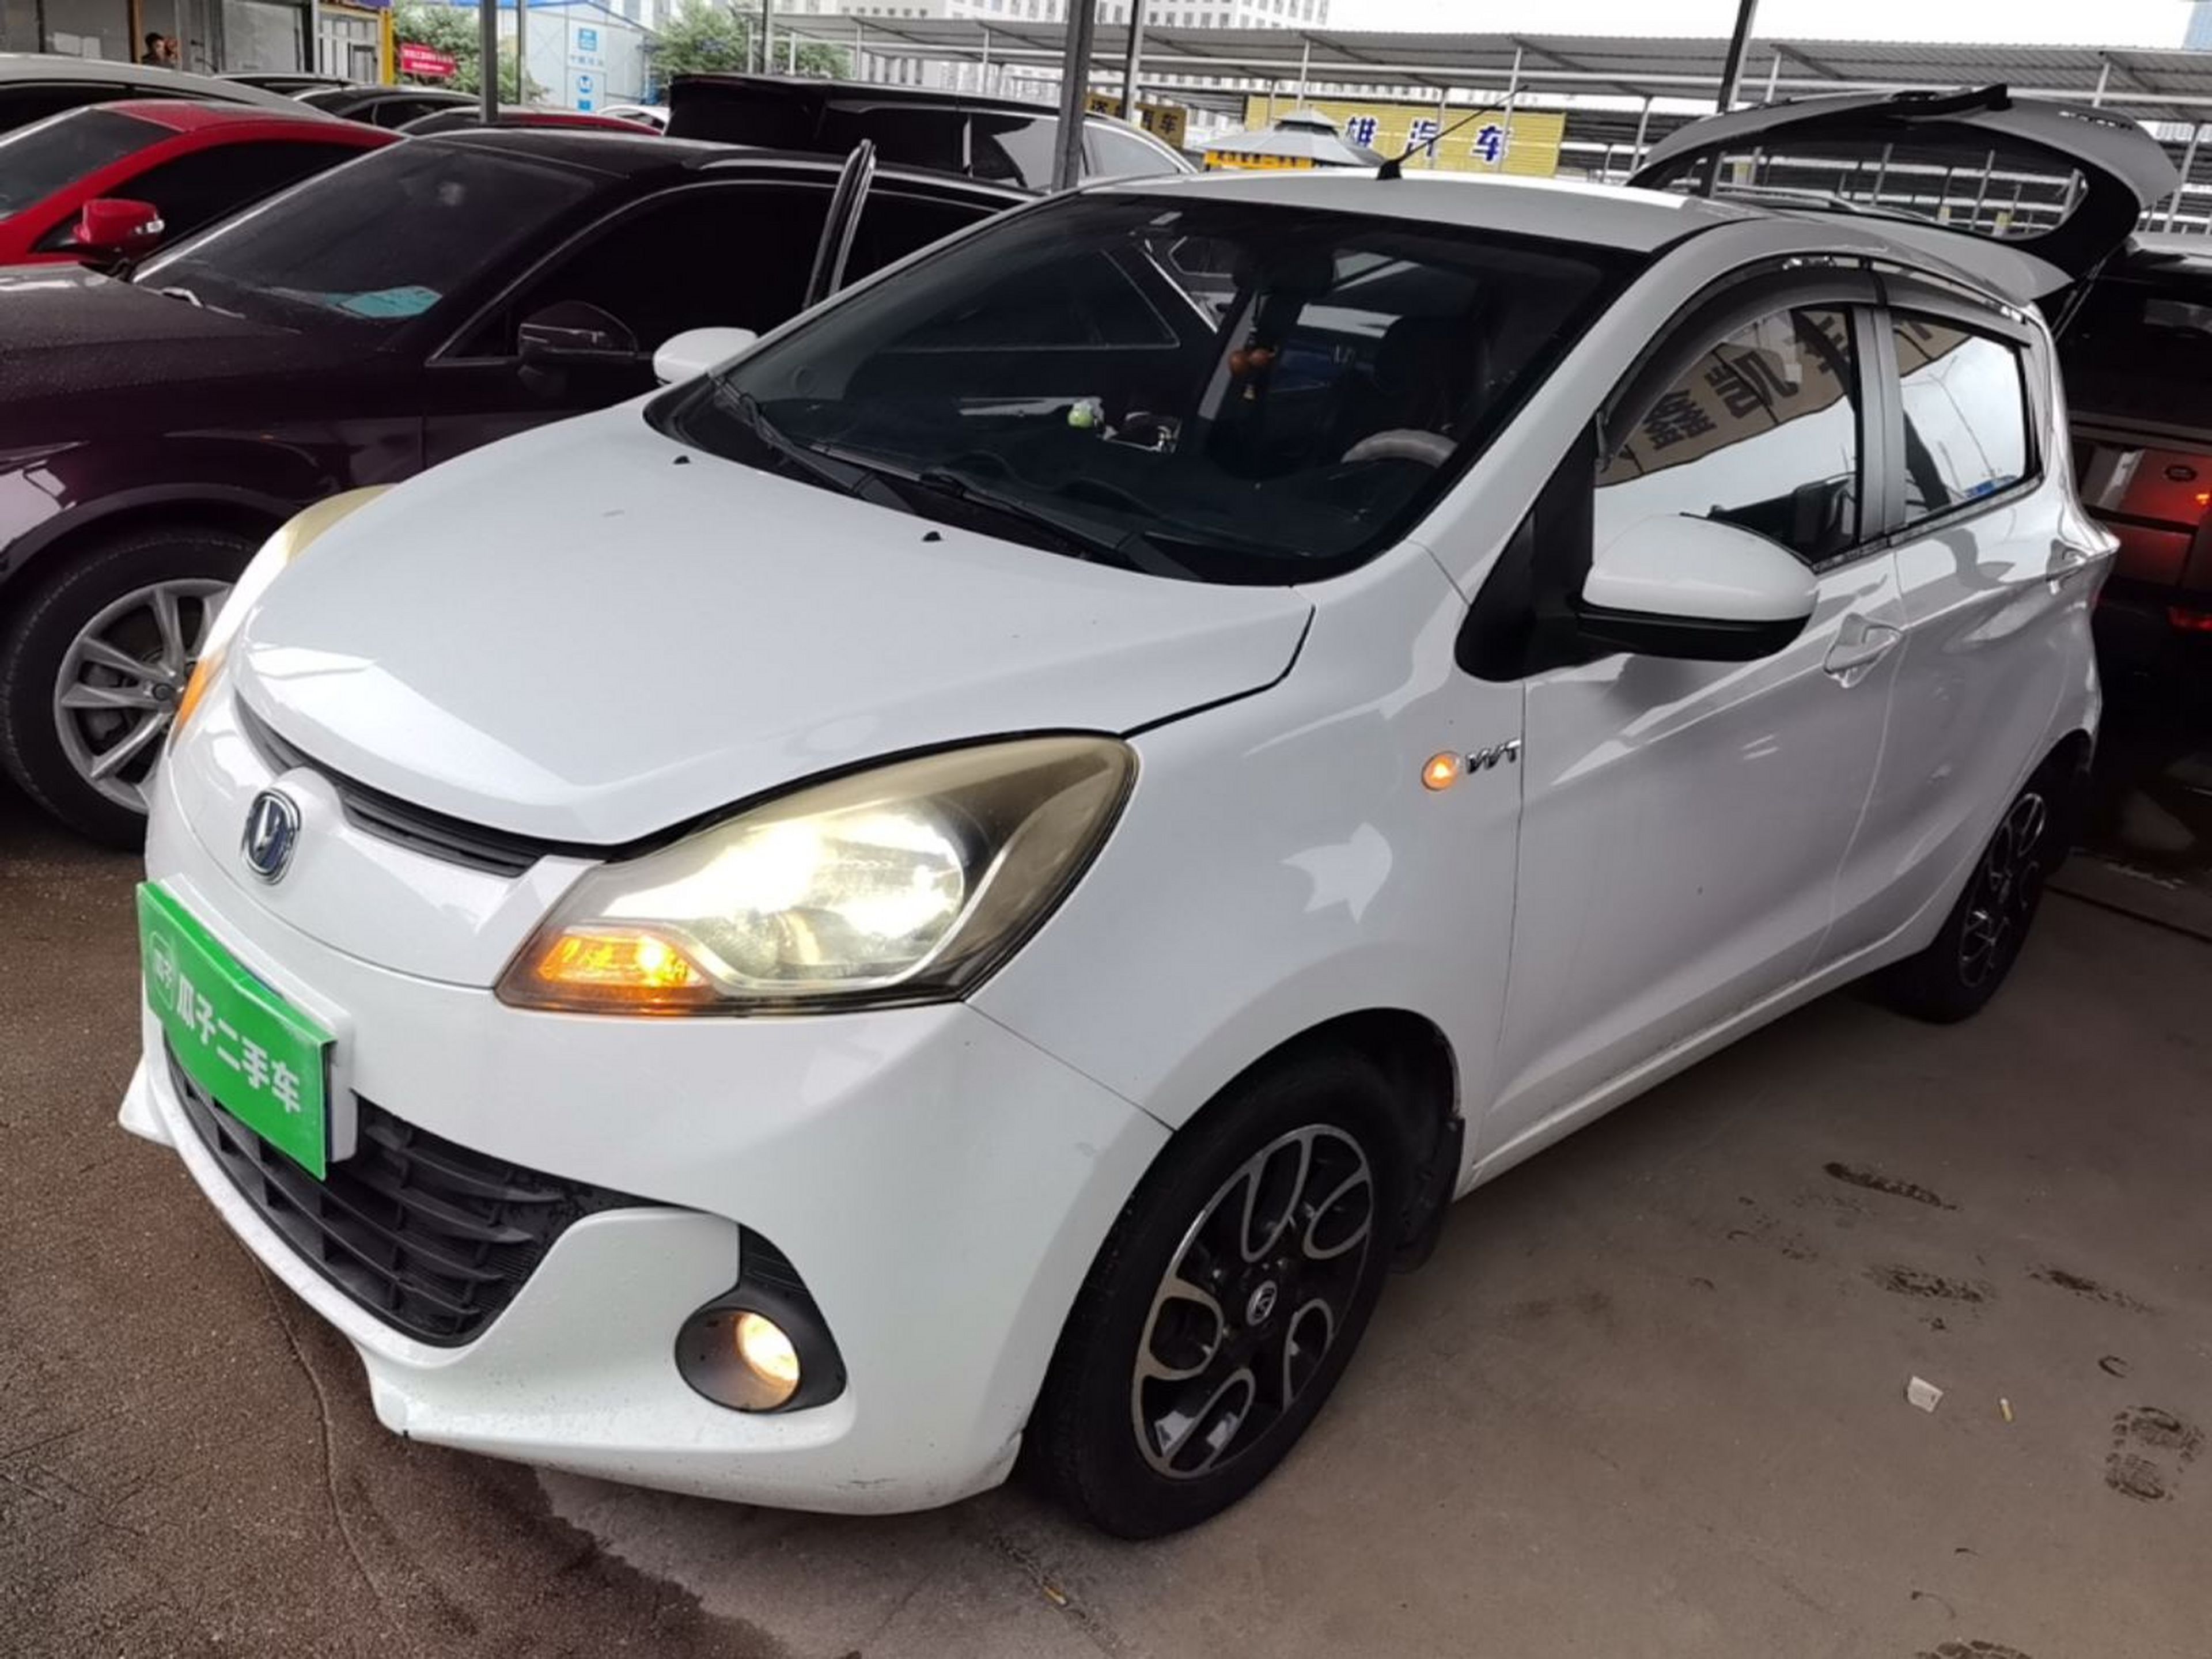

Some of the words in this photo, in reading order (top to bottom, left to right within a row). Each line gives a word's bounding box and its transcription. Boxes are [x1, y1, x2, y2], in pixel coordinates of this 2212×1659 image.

[176, 972, 301, 1113] 瓜子二手车
